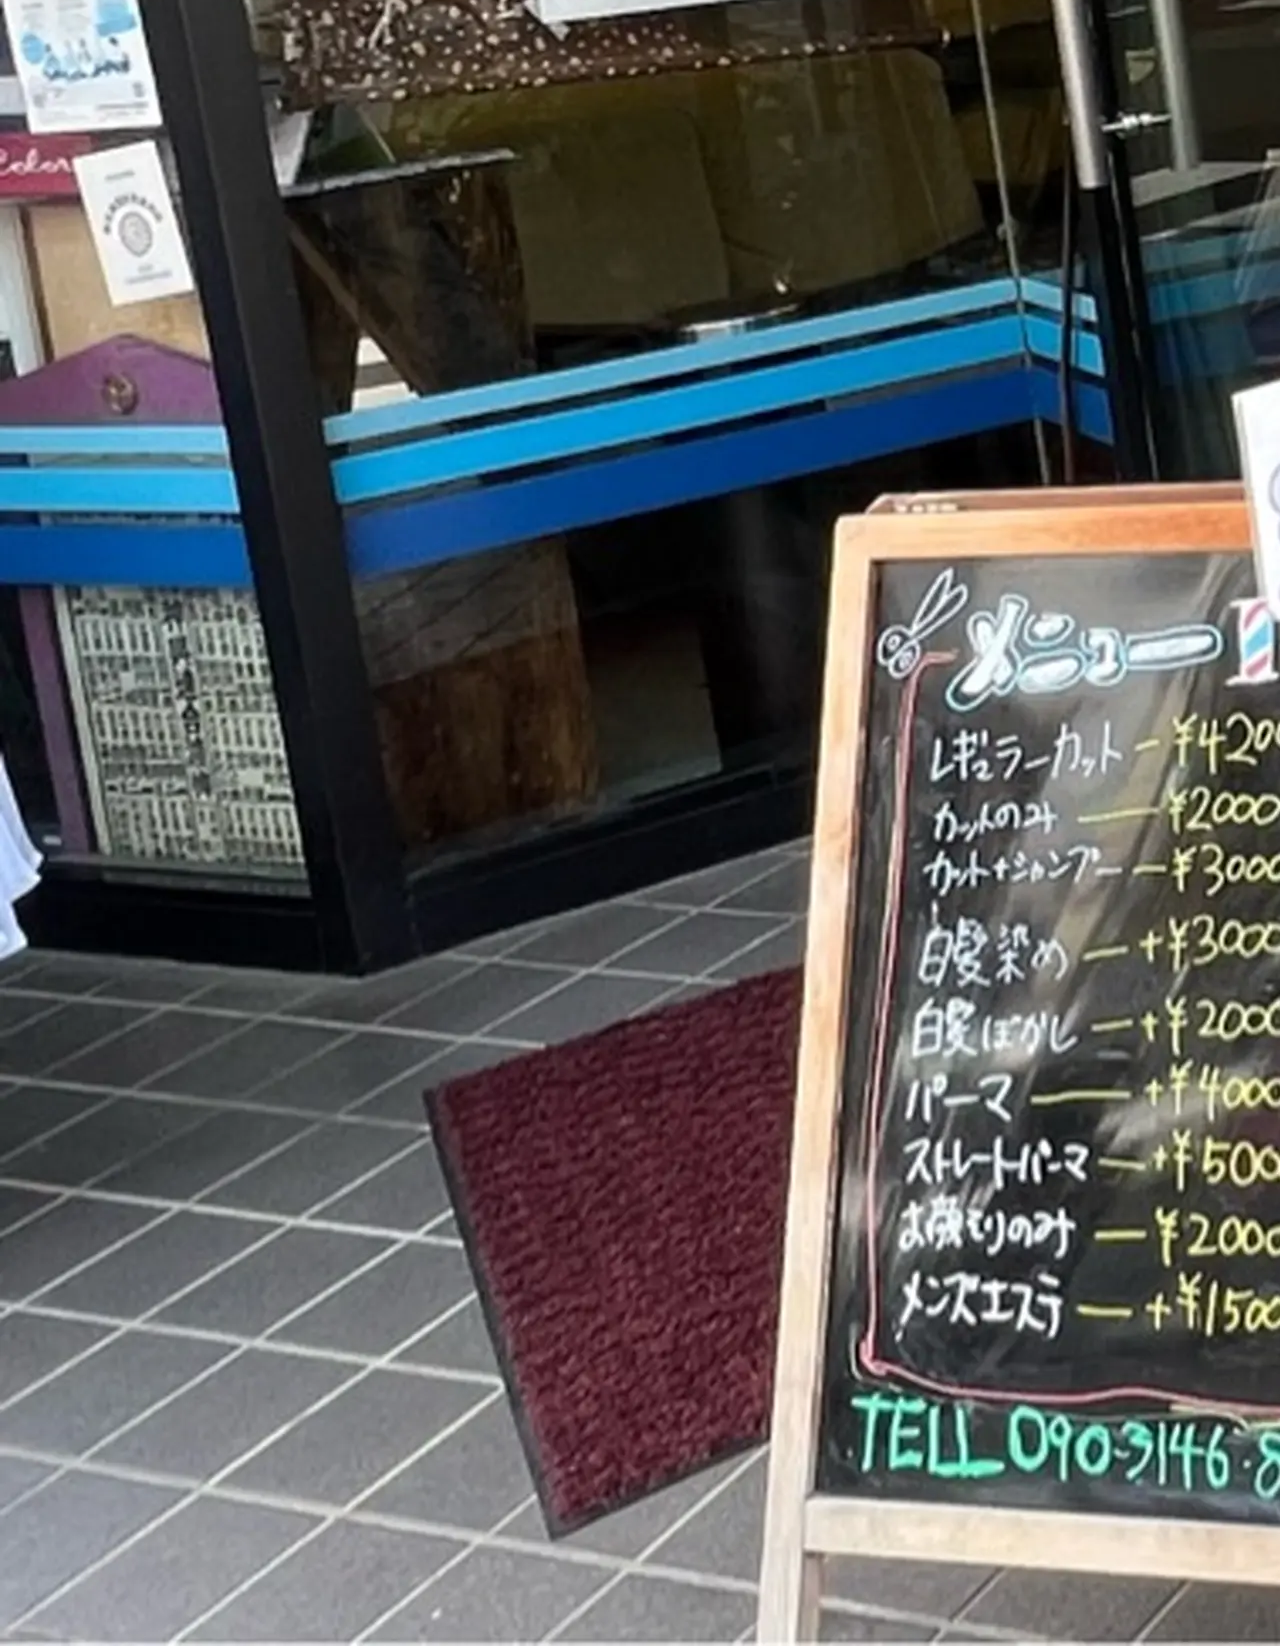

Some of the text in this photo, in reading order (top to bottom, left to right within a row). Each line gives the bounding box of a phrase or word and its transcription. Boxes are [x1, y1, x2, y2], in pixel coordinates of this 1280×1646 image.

[946, 594, 1224, 712] メニュー
[929, 720, 1124, 784] レギュラーカット
[904, 1072, 1014, 1124] パーマ
[896, 1271, 1064, 1343] メンズエステ
[850, 1391, 1005, 1476] TELL
